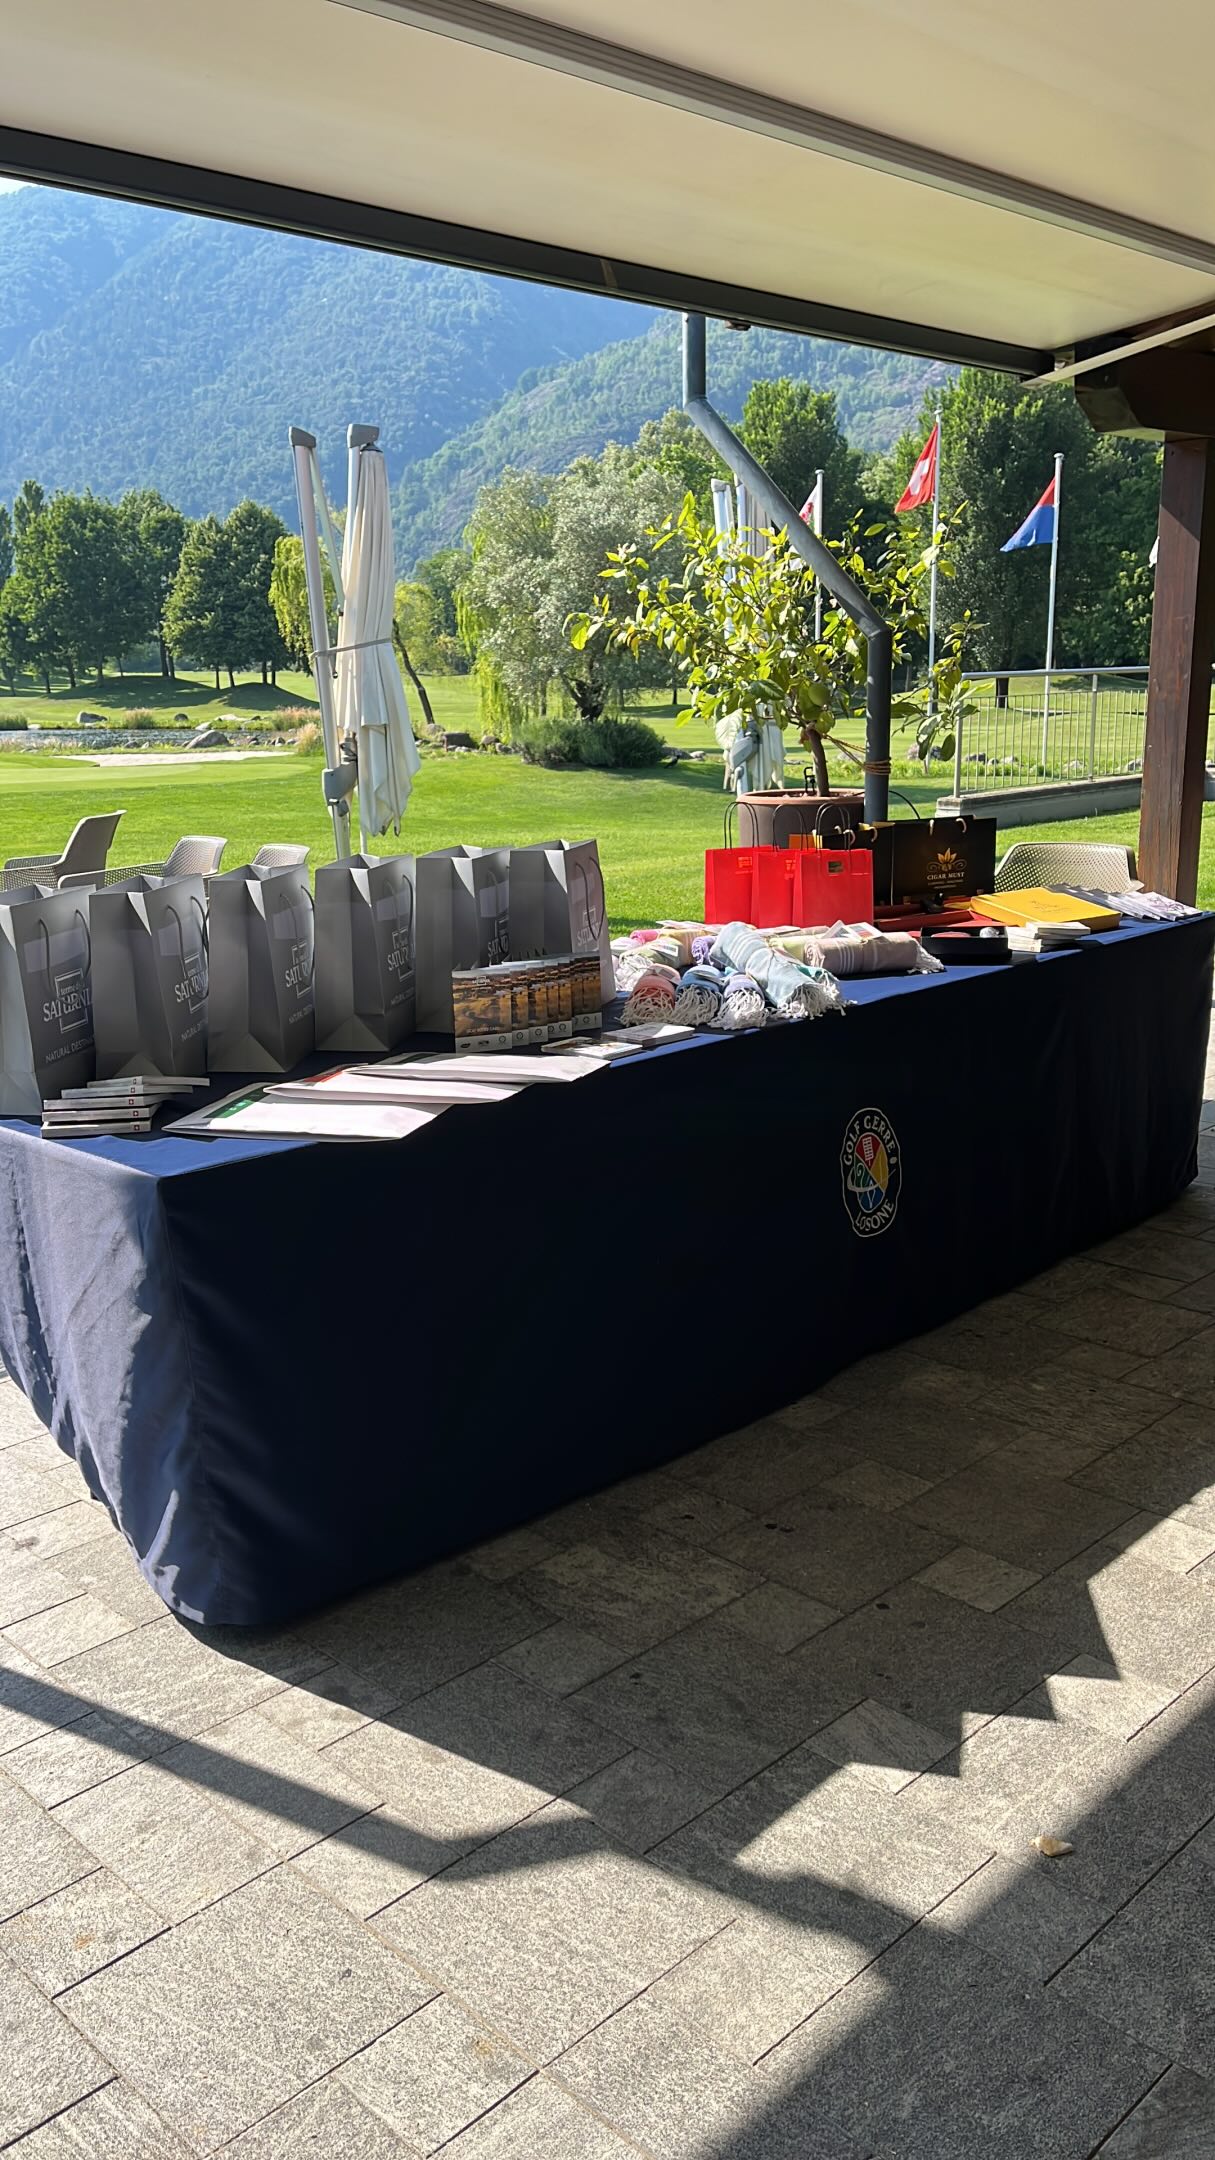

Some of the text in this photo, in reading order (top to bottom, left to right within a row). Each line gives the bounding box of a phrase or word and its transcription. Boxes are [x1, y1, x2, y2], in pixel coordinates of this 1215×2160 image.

[926, 873, 947, 881] CIGAR
[43, 987, 91, 1022] SATURNI
[843, 1115, 897, 1166] GOLF GERRE
